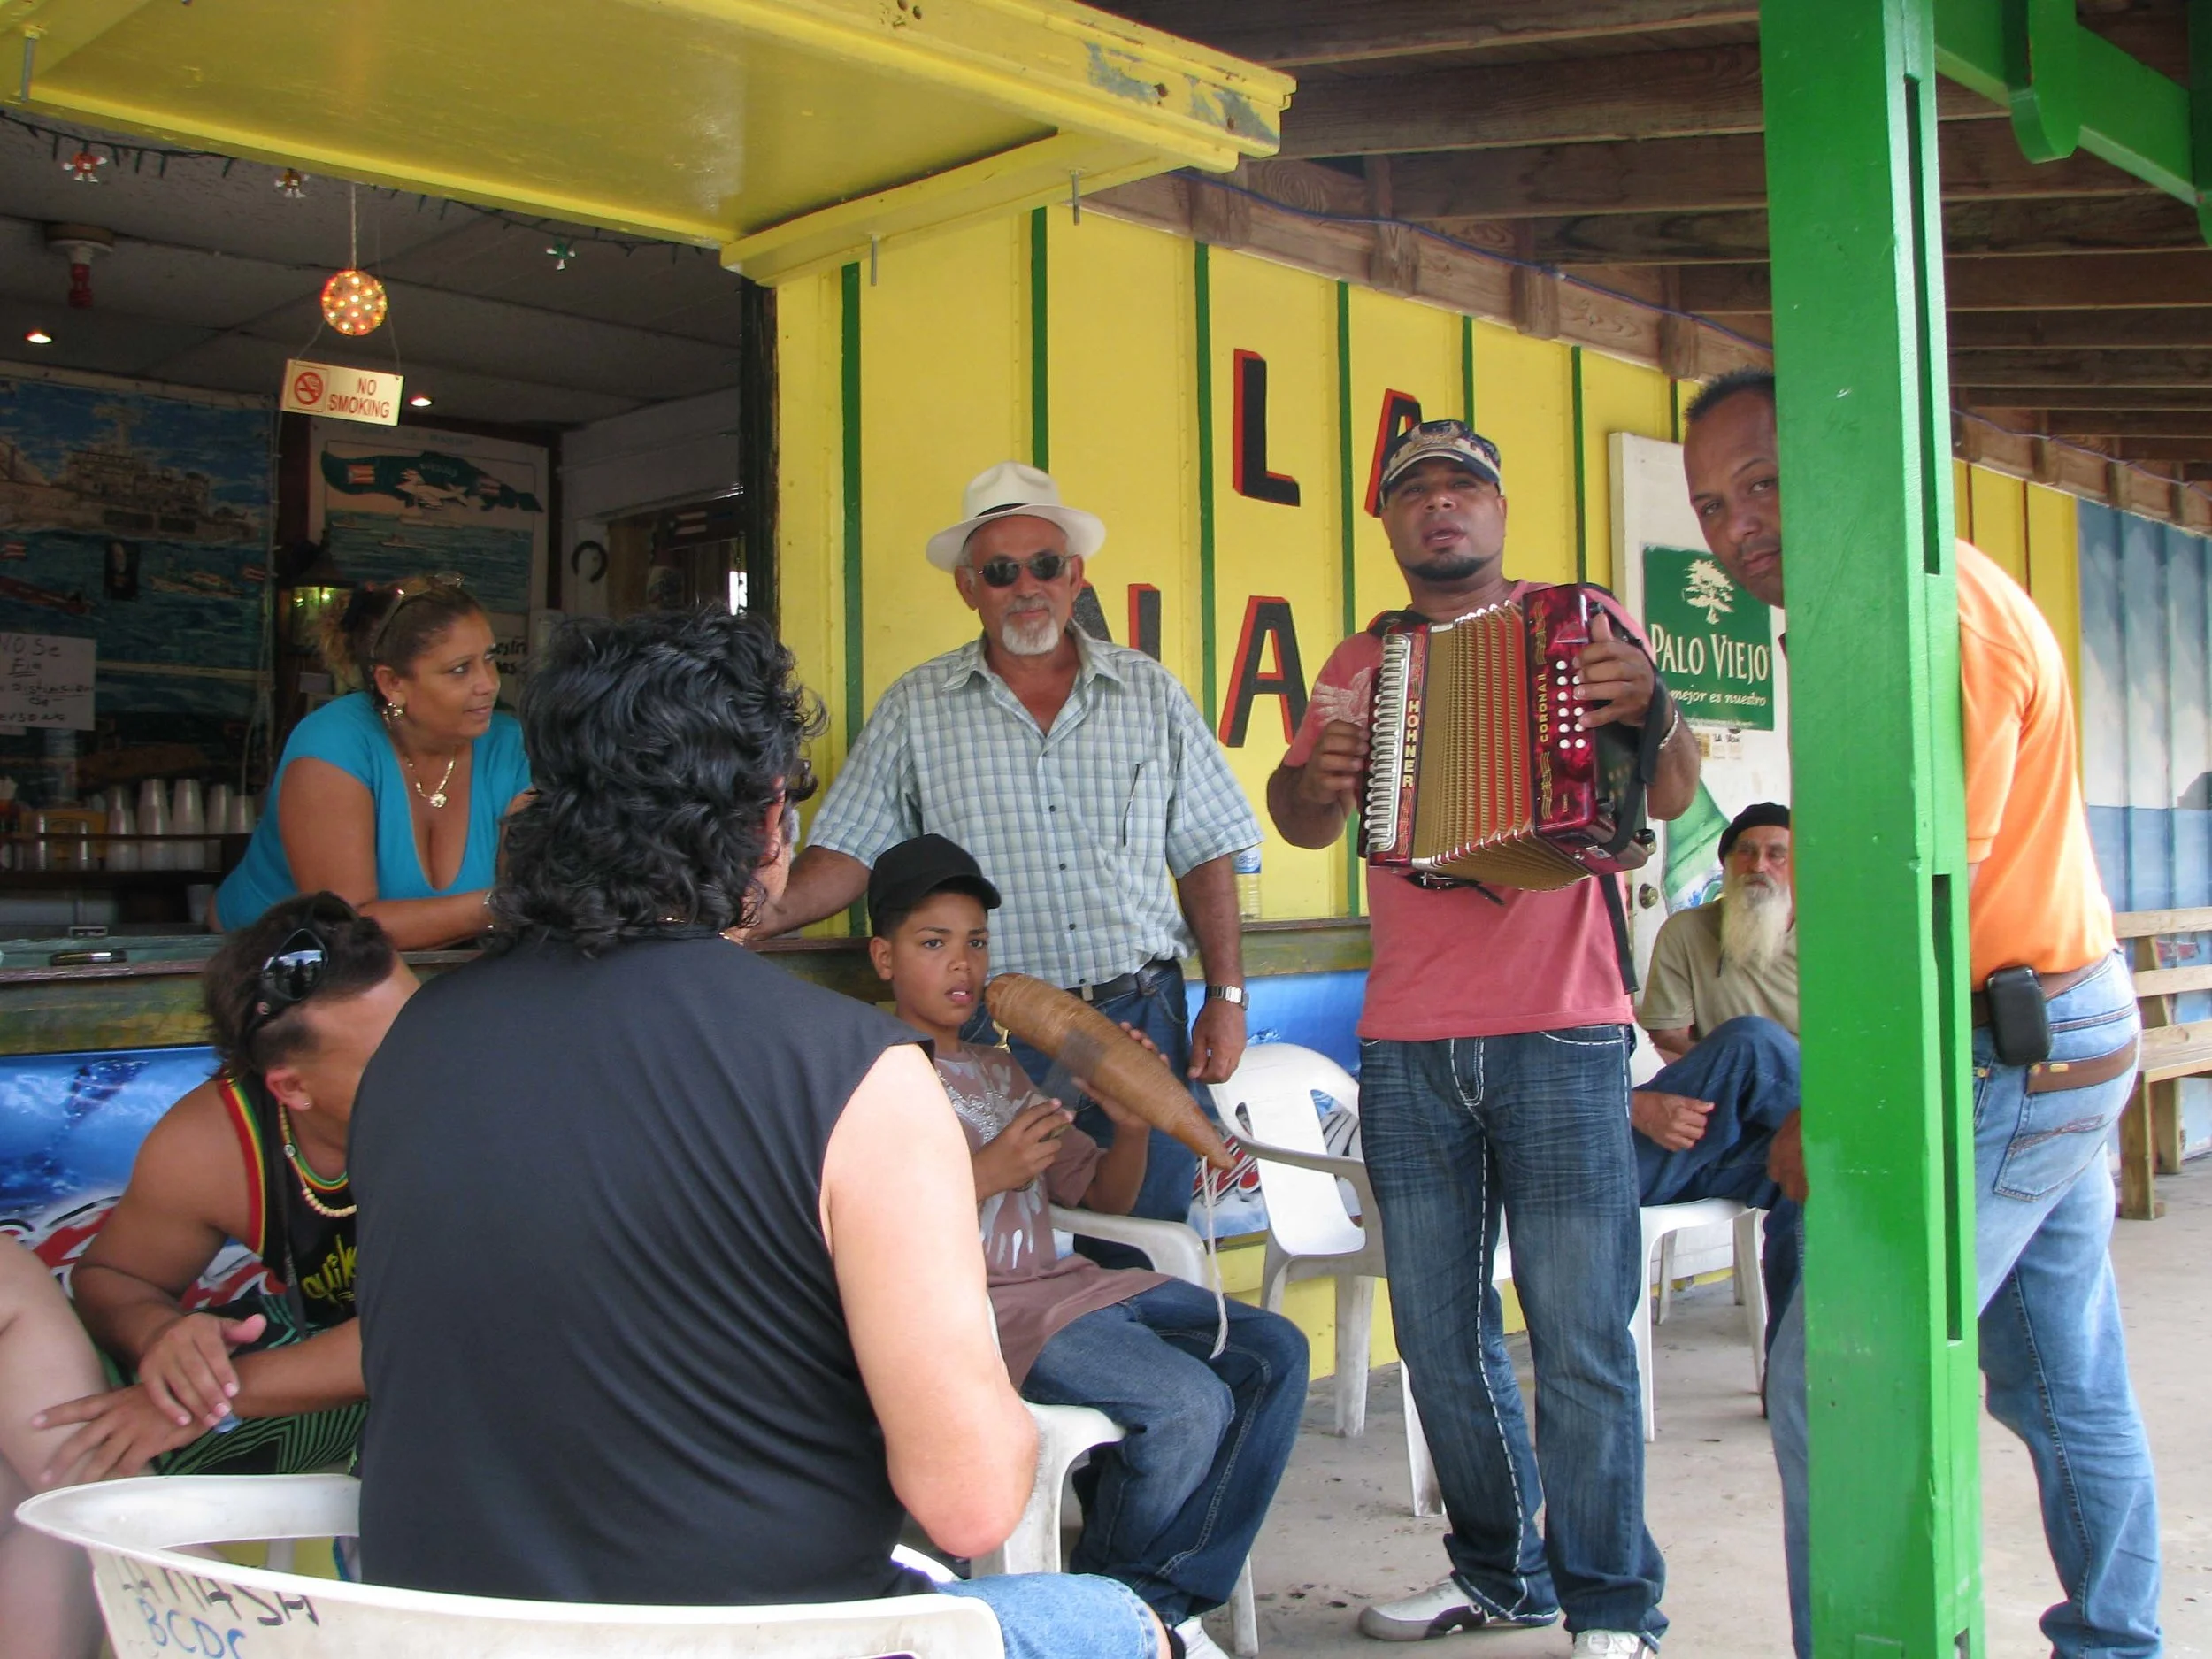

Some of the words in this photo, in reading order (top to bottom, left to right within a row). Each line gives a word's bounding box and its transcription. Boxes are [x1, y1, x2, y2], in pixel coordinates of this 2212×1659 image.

[327, 394, 390, 418] SMOKING
[357, 377, 377, 396] NO
[1650, 623, 1705, 676] PALO
[1709, 634, 1769, 685] VIEJO
[1536, 683, 1549, 744] CORONA
[1669, 684, 1708, 705] mejor
[1709, 693, 1722, 703] es
[1724, 691, 1768, 707] nuestro
[1402, 700, 1420, 788] HOHNER
